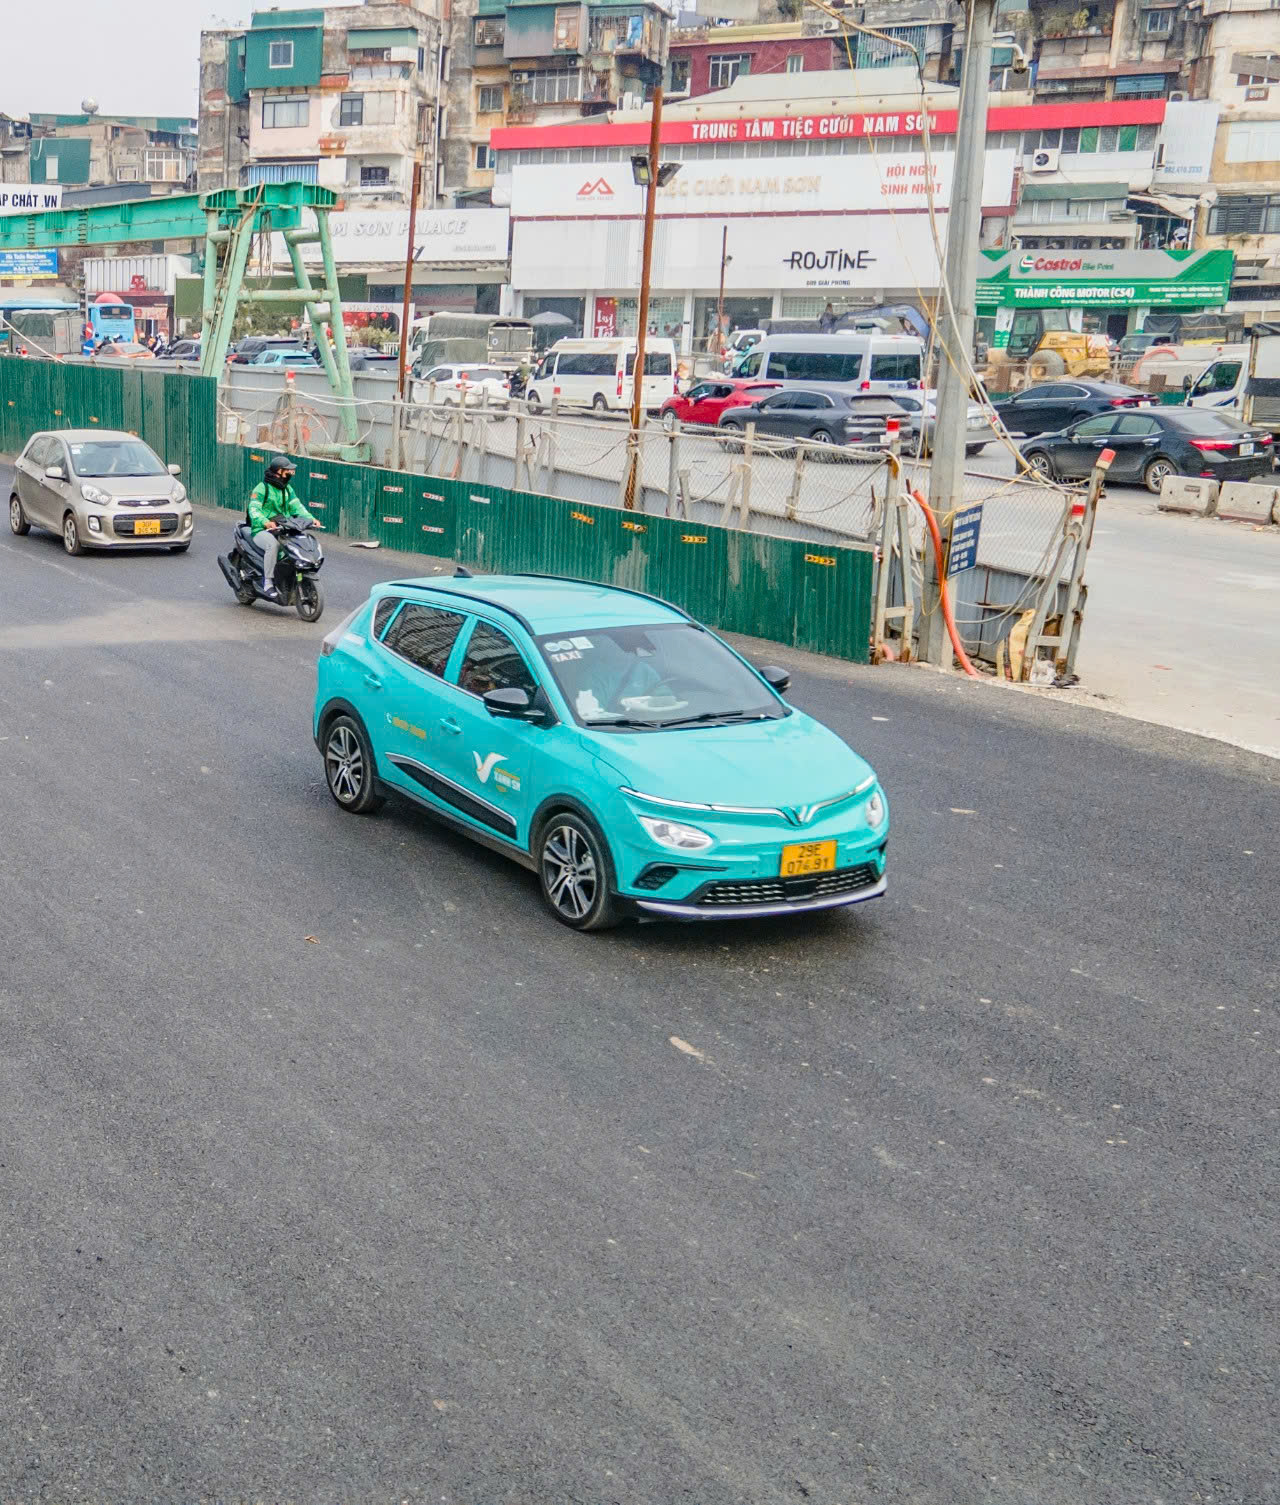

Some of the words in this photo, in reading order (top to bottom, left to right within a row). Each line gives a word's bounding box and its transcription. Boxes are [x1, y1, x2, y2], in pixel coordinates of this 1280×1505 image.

[692, 122, 738, 139] TRUNG
[745, 119, 774, 138] TÂM
[782, 117, 814, 139] TIỆC
[819, 114, 854, 135] CƯỚI
[862, 115, 899, 133] NAM
[887, 163, 906, 179] HỘI
[880, 183, 909, 195] SINH
[783, 249, 877, 271] ROUTINE
[1034, 257, 1082, 271] Castrol
[1014, 285, 1049, 298] THÀNH
[1049, 285, 1076, 298] CÔNG
[1077, 287, 1110, 298] MOTOR
[551, 650, 583, 662] TAXI
[798, 843, 822, 858] 29E
